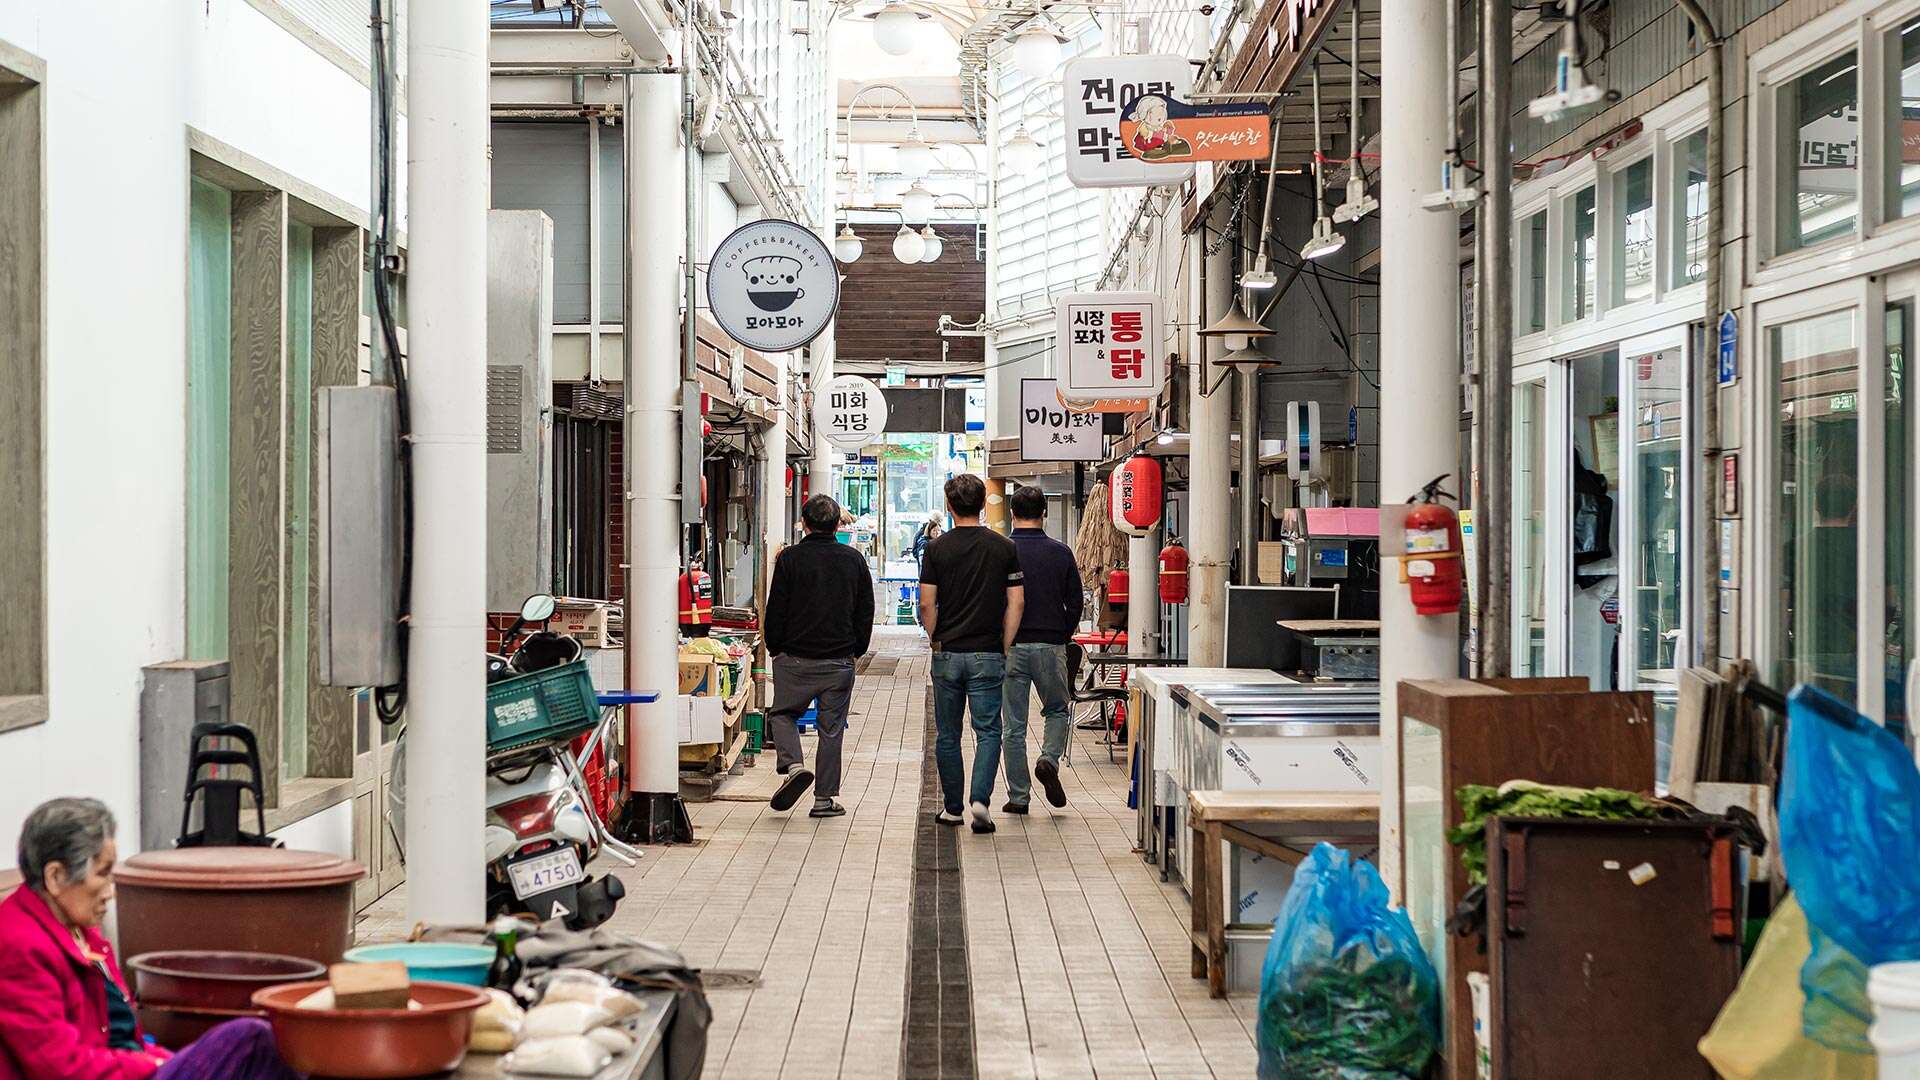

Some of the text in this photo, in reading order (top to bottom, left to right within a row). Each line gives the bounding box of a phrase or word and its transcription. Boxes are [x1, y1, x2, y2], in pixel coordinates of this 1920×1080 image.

[1077, 127, 1136, 163] 막
[1195, 127, 1263, 151] 맛나반찬
[746, 316, 804, 330] 모아모아
[1073, 311, 1105, 327] 시장
[1074, 329, 1106, 345] 포차
[1110, 311, 1146, 380] 통닭
[1097, 349, 1105, 360] &
[830, 391, 868, 410] 미화
[831, 413, 869, 432] 식당
[1049, 432, 1078, 445] 美味
[533, 863, 576, 887] 4750
